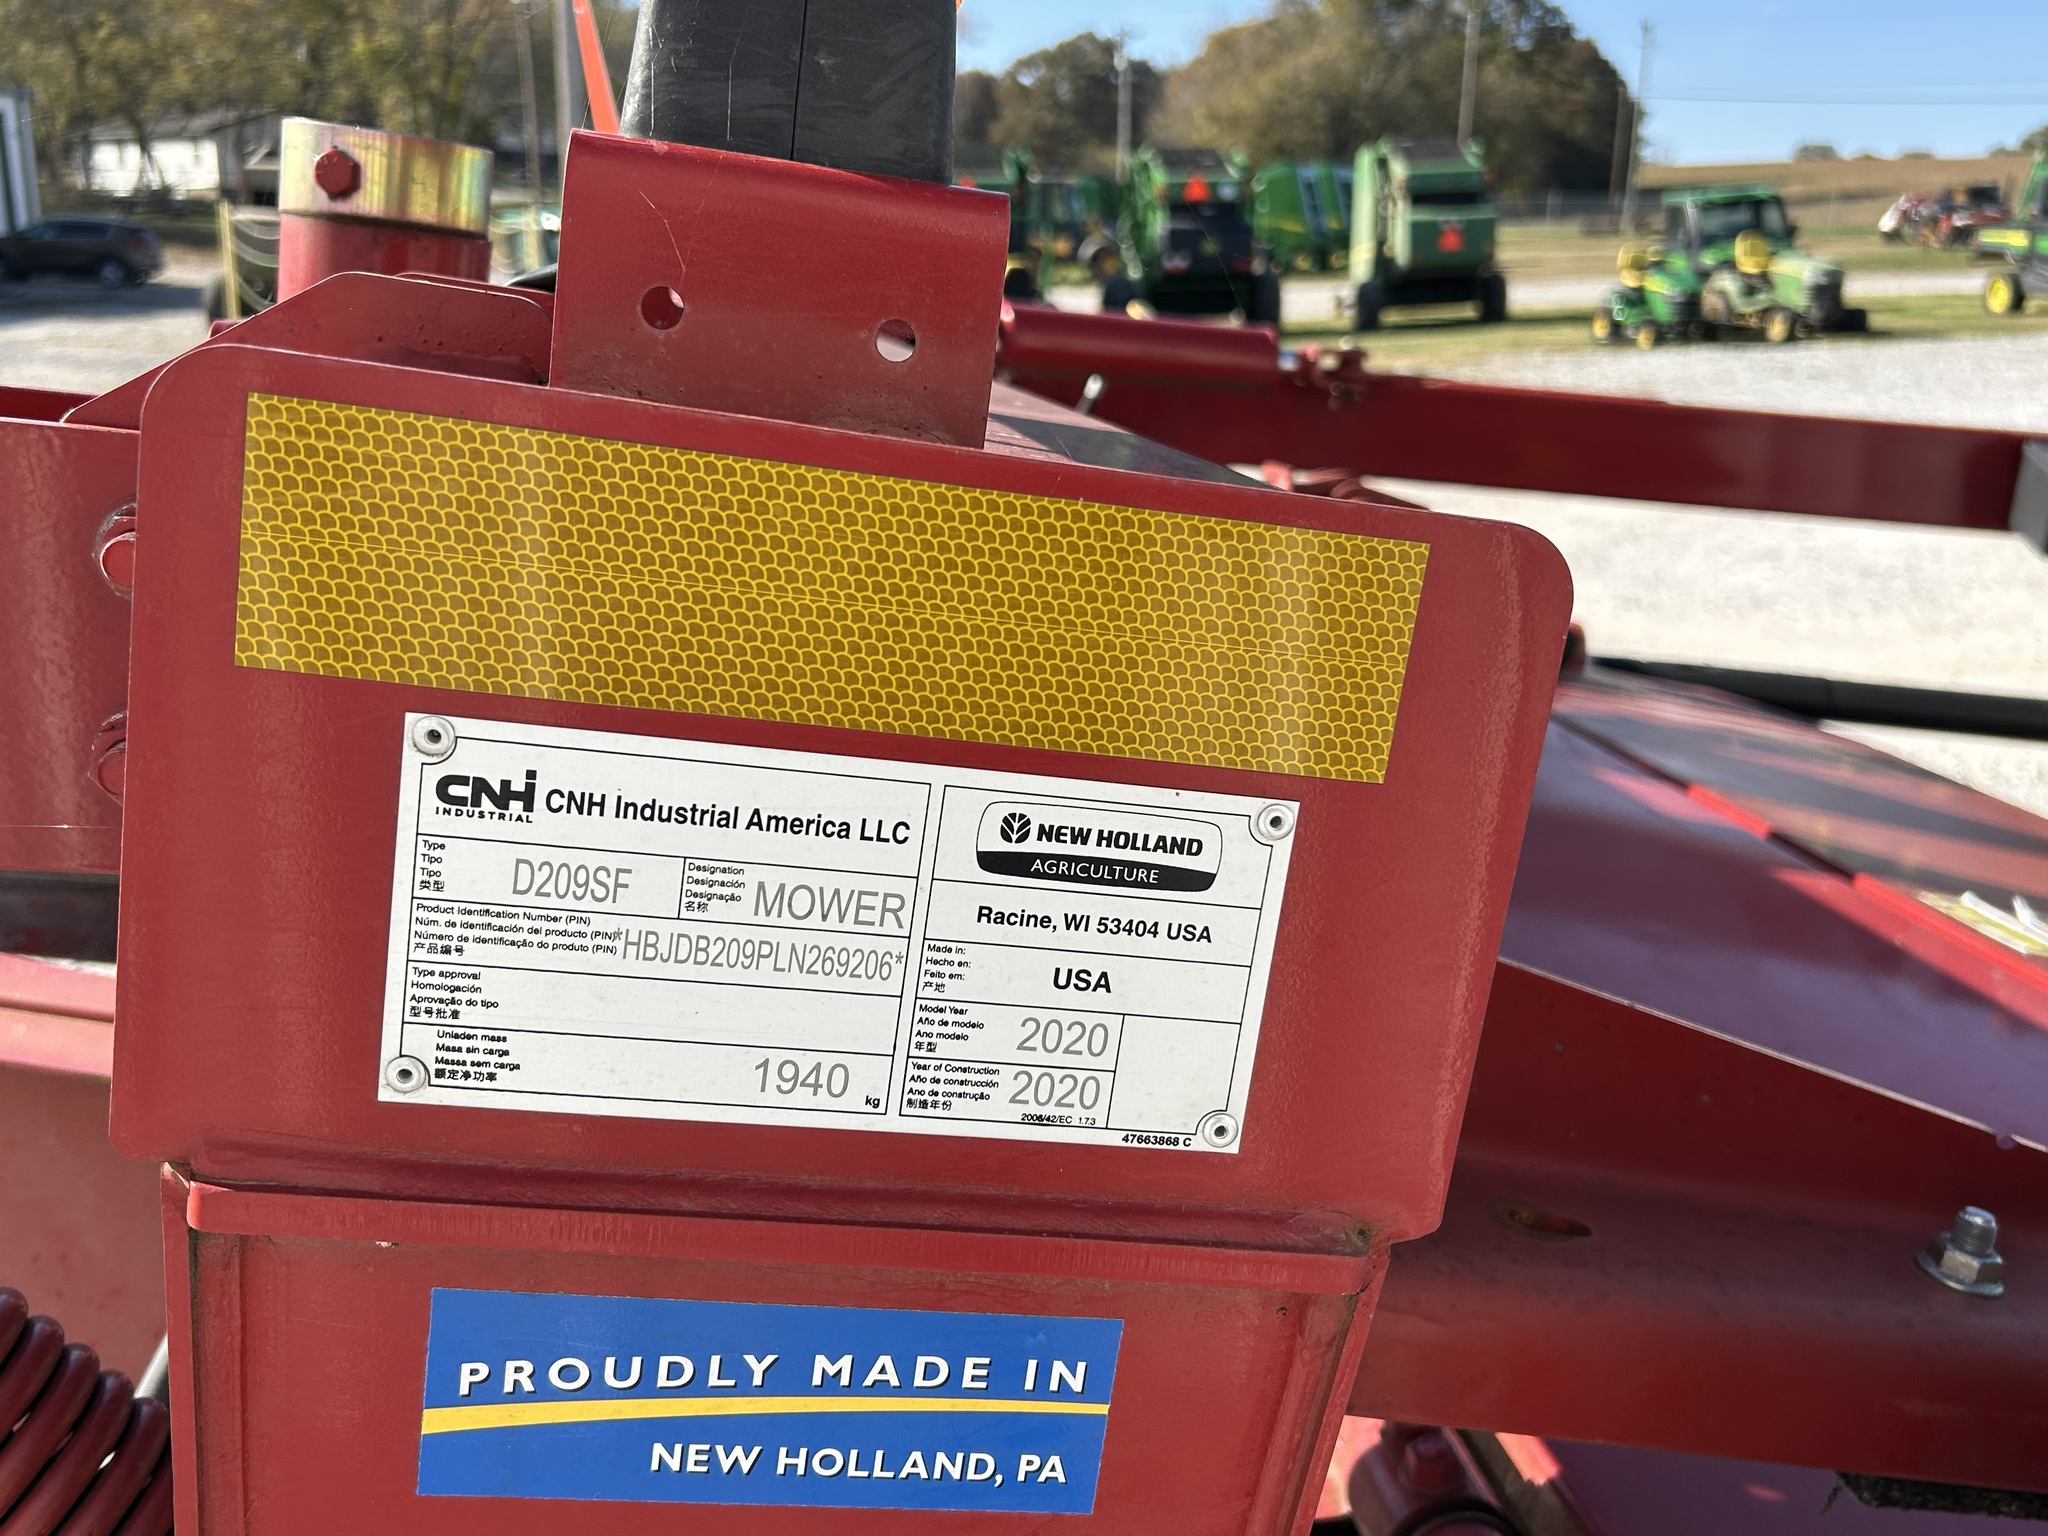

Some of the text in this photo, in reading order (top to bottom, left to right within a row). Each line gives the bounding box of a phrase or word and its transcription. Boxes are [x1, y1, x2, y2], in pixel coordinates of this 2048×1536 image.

[435, 806, 533, 824] INDUSTRIAL
[545, 788, 911, 845] CNH Industrial America LLC
[422, 840, 445, 850] Type
[1036, 823, 1203, 857] NEW HOLLAND
[421, 854, 443, 864] Tipo
[420, 868, 441, 878] Tipo
[688, 862, 745, 875] Designation
[1030, 859, 1160, 884] AGRICULTURE
[419, 879, 445, 892] 类型
[512, 858, 632, 904] D209SF
[686, 876, 745, 889] Designación
[685, 889, 742, 903] Designação
[684, 901, 709, 913] 名称
[753, 880, 906, 929] MOWER
[416, 903, 591, 926] Product Identification Number (PIN)
[415, 917, 616, 942] Núm. de identificación del producto (PIN)
[977, 905, 1212, 943] Racine, WI 53404 USA
[413, 942, 465, 956] 产品编号
[414, 931, 617, 955] Número de identificação do produto (PIN)
[927, 943, 966, 955] Made in:
[925, 957, 971, 968] Hecho en:
[412, 967, 481, 980] Type approval
[924, 969, 966, 981] Feito em:
[1053, 967, 1112, 994] USA
[411, 980, 482, 994] Homologación
[922, 981, 946, 993] 产地
[410, 994, 499, 1009] Aprovação do tipo
[409, 1006, 461, 1020] 型号批准
[919, 1004, 968, 1016] Model Year
[917, 1016, 984, 1030] Año de modelo
[437, 1029, 507, 1043] Unladen mass
[915, 1029, 969, 1042] Ano modelo
[1016, 1016, 1109, 1058] 2020
[435, 1043, 510, 1057] Masa sin carga
[914, 1041, 937, 1053] 年型
[435, 1056, 521, 1072] Massa sem carga
[911, 1061, 1000, 1076] Year of Construction
[754, 1057, 881, 1108] 1940 kg
[908, 1074, 999, 1089] Año de construcción
[907, 1087, 991, 1102] Ano de construção
[1008, 1070, 1101, 1111] 2020
[906, 1098, 952, 1112] 制造年份
[1078, 1116, 1097, 1126] 1.7.3
[1122, 1133, 1192, 1147] 47663868 C
[459, 1354, 1088, 1395] PROUDLY MADE IN
[651, 1442, 1067, 1488] NEW HOLLAND, PA
